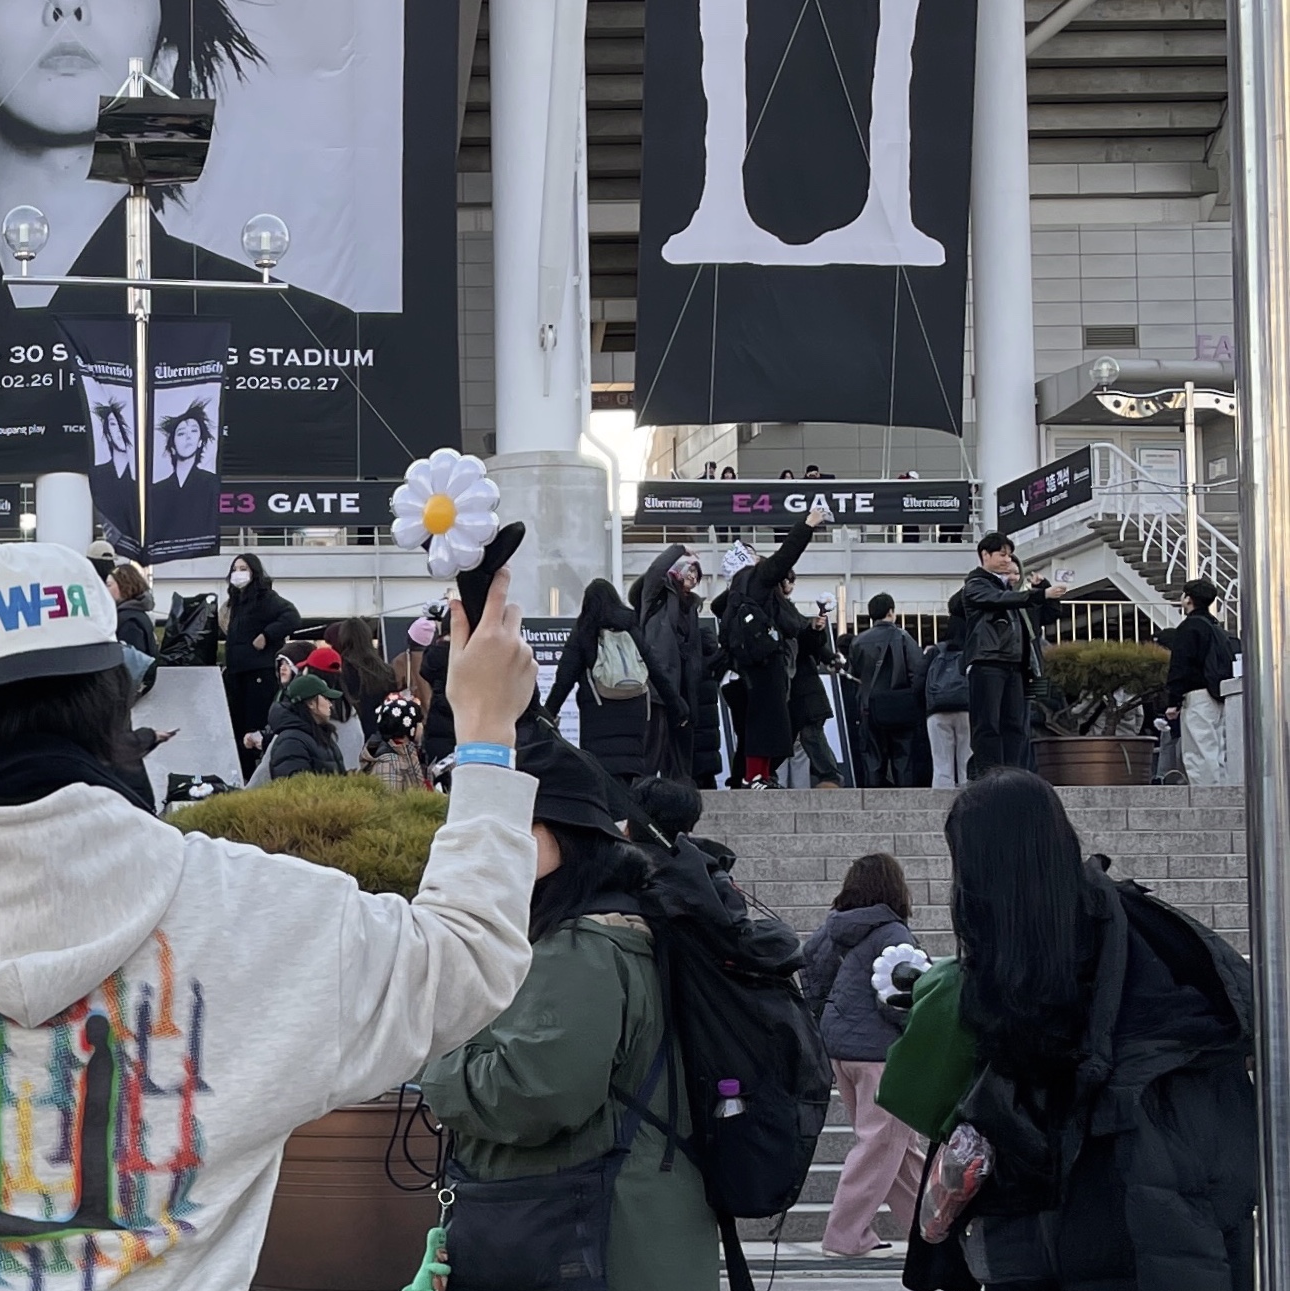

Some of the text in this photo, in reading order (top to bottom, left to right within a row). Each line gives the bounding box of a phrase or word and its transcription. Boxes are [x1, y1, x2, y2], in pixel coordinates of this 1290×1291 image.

[9, 345, 44, 363] 30
[1196, 334, 1233, 361] EA
[226, 347, 375, 367] G STADIUM
[154, 361, 224, 379] Übermensch
[235, 376, 339, 392] 2025.02.27
[62, 424, 87, 433] TICK
[218, 492, 360, 514] E3 GATE
[644, 494, 703, 510] Übermensch
[731, 492, 875, 513] E4 GATE
[902, 494, 960, 509] Übermensch
